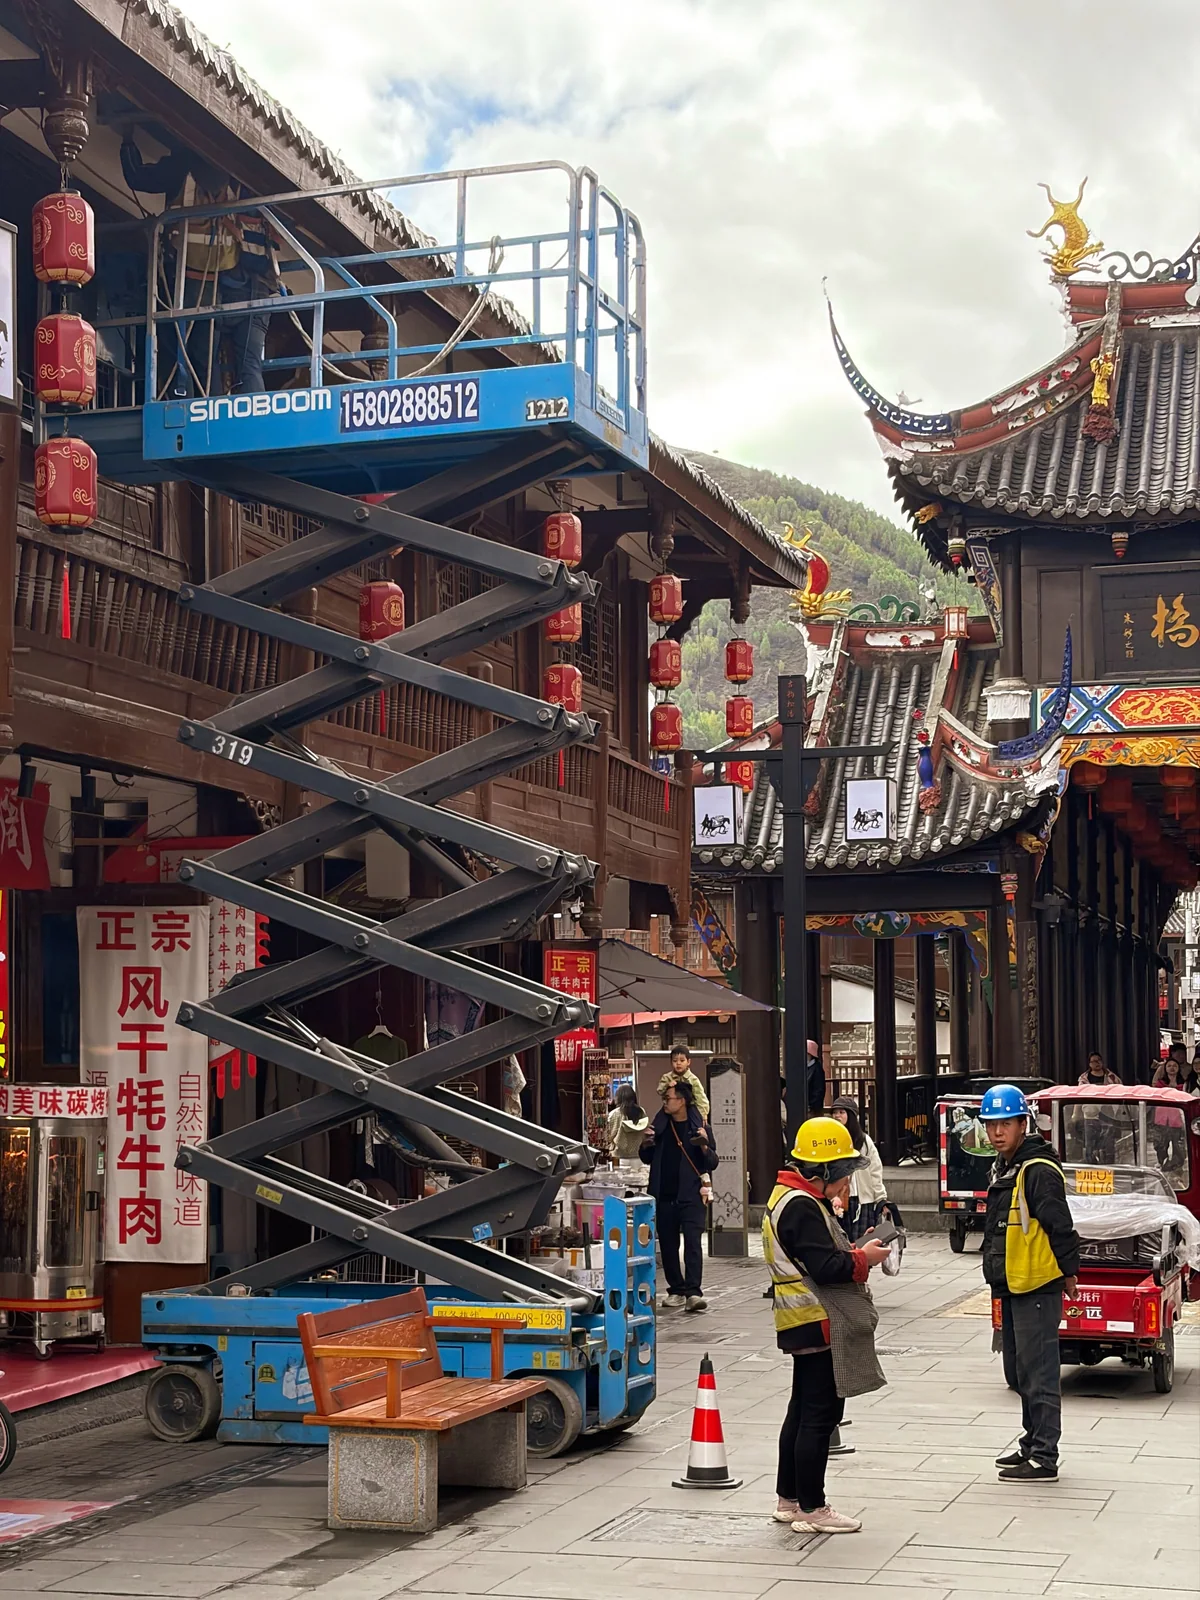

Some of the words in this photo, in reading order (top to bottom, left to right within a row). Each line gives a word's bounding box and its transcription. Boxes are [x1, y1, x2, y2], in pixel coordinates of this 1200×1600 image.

[190, 389, 332, 422] SINOBOOM
[342, 382, 478, 427] 15802888512
[527, 397, 569, 420] 1212
[212, 735, 253, 766] 319
[209, 905, 246, 921] 牛肉
[96, 911, 192, 953] 正宗
[209, 923, 246, 939] 牛肉
[209, 941, 246, 957] 牛肉
[209, 959, 246, 975] 牛肉
[551, 956, 591, 973] 正宗
[551, 976, 591, 989] 牦牛肉干
[0, 1087, 109, 1116] 美味碳烤
[117, 966, 169, 1245] 风干牦牛肉
[812, 1138, 838, 1148] B-196
